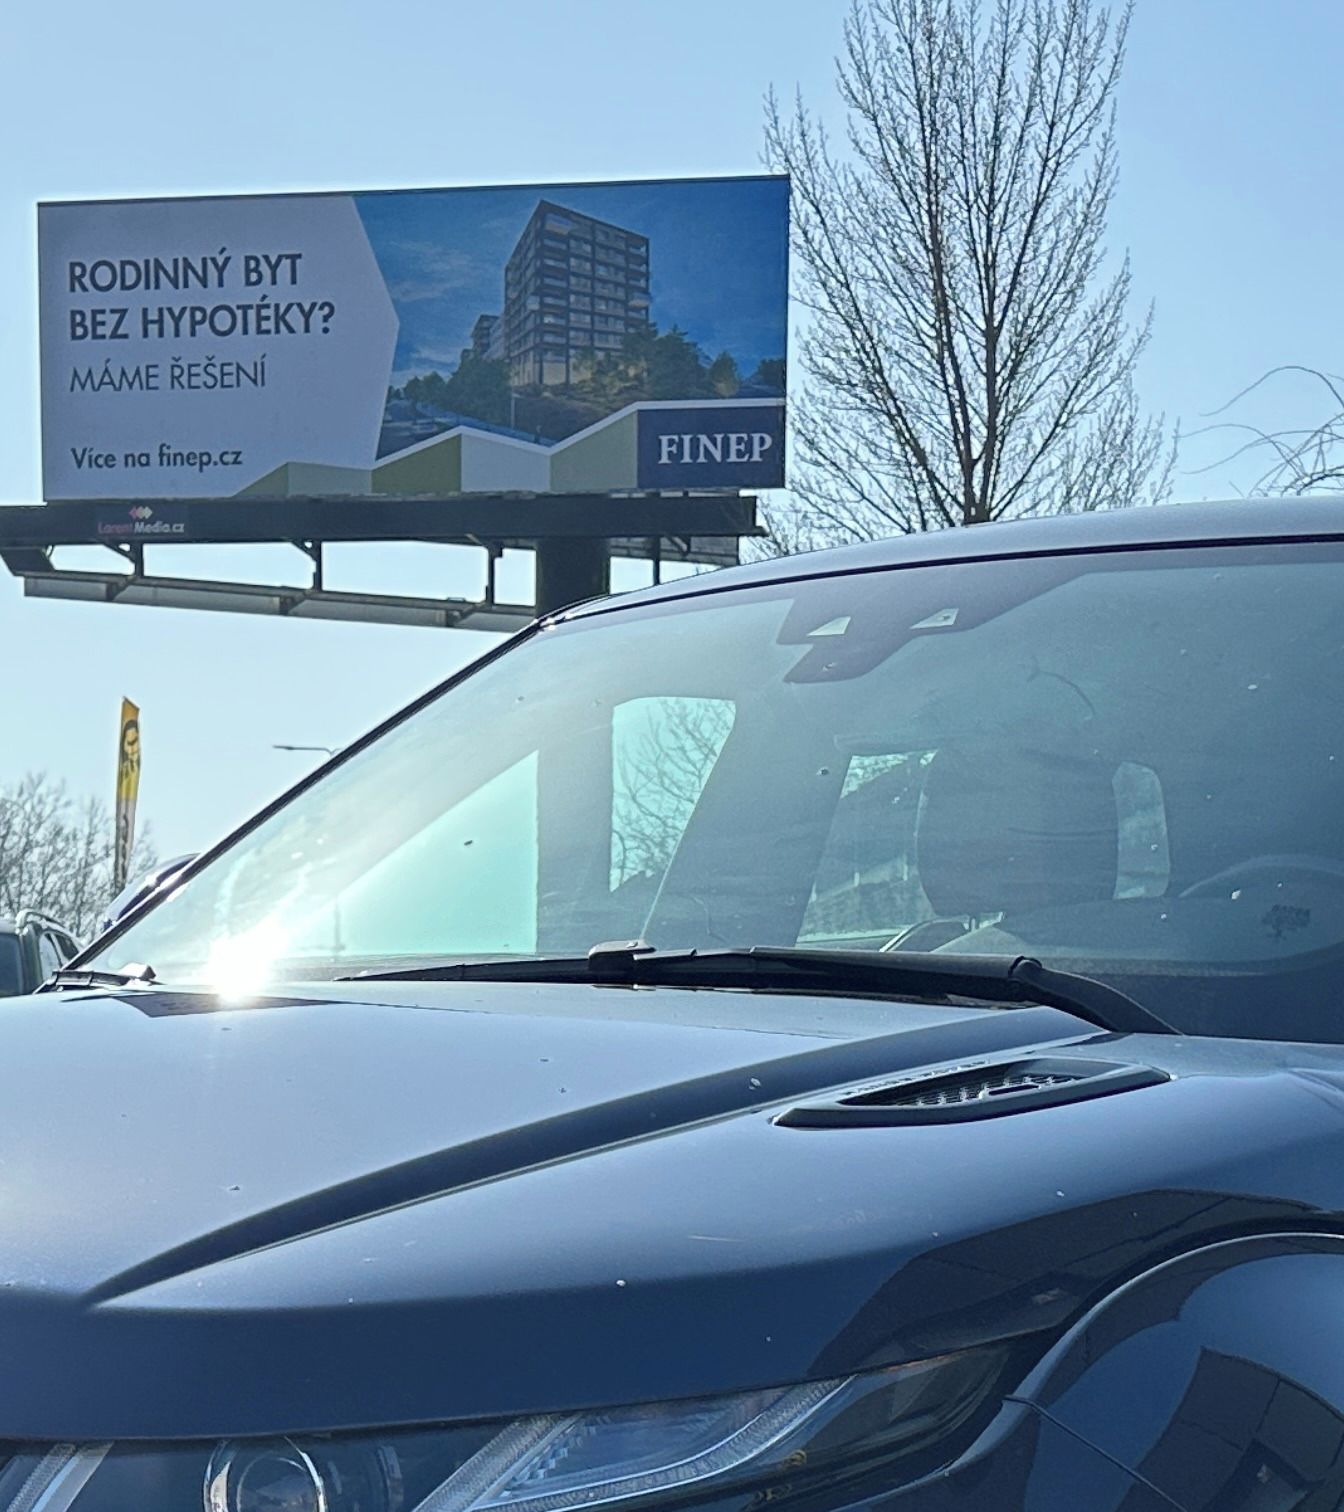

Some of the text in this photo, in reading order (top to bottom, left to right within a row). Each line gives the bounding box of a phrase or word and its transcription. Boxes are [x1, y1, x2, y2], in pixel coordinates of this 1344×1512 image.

[68, 246, 303, 293] RODINNÝ BYT
[70, 294, 336, 341] BEZ HYPOTÉKY?
[69, 353, 267, 392] MÁME ŘEŠENÍ
[70, 443, 243, 473] Více na finep.cz
[657, 432, 773, 464] FINEP
